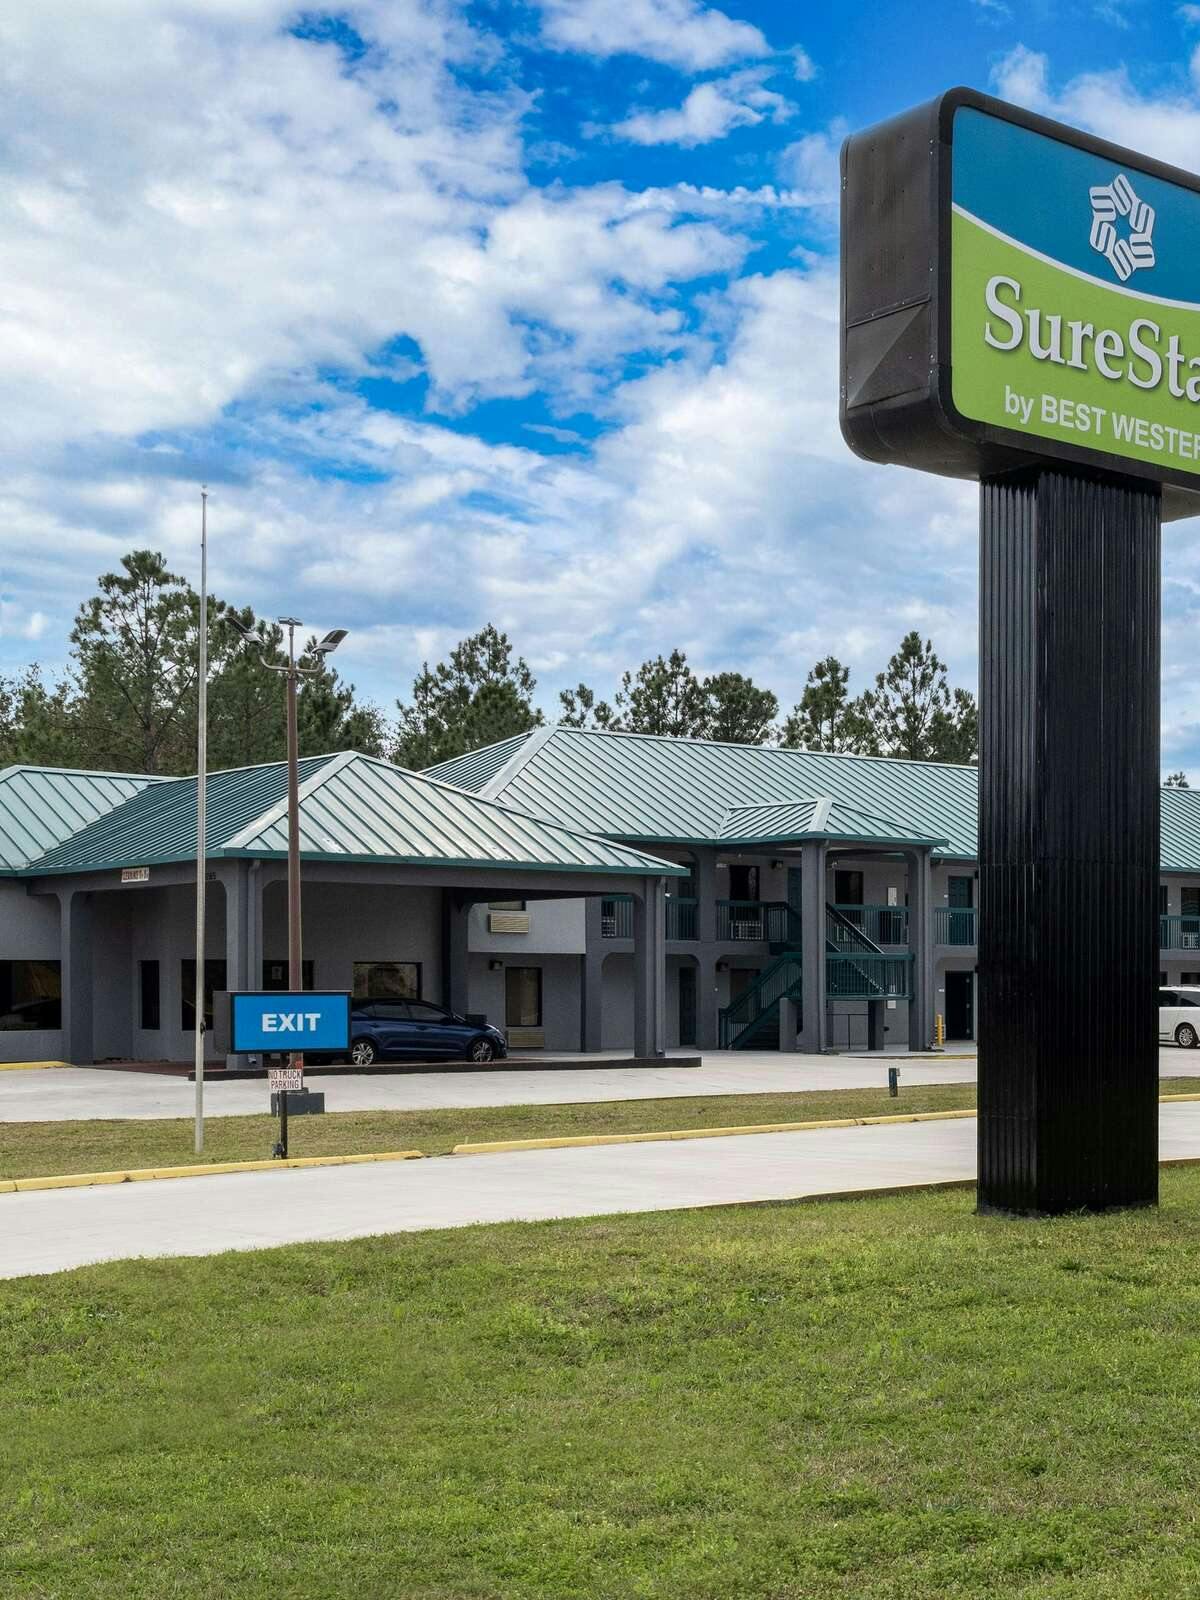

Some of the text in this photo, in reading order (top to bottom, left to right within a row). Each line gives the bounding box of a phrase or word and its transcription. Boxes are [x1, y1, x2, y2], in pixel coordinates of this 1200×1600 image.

[1005, 385, 1034, 424] by
[1041, 394, 1107, 435] BEST
[262, 1013, 321, 1032] EXIT
[269, 1071, 301, 1080] NO TRUCK
[271, 1080, 299, 1089] PARKING
